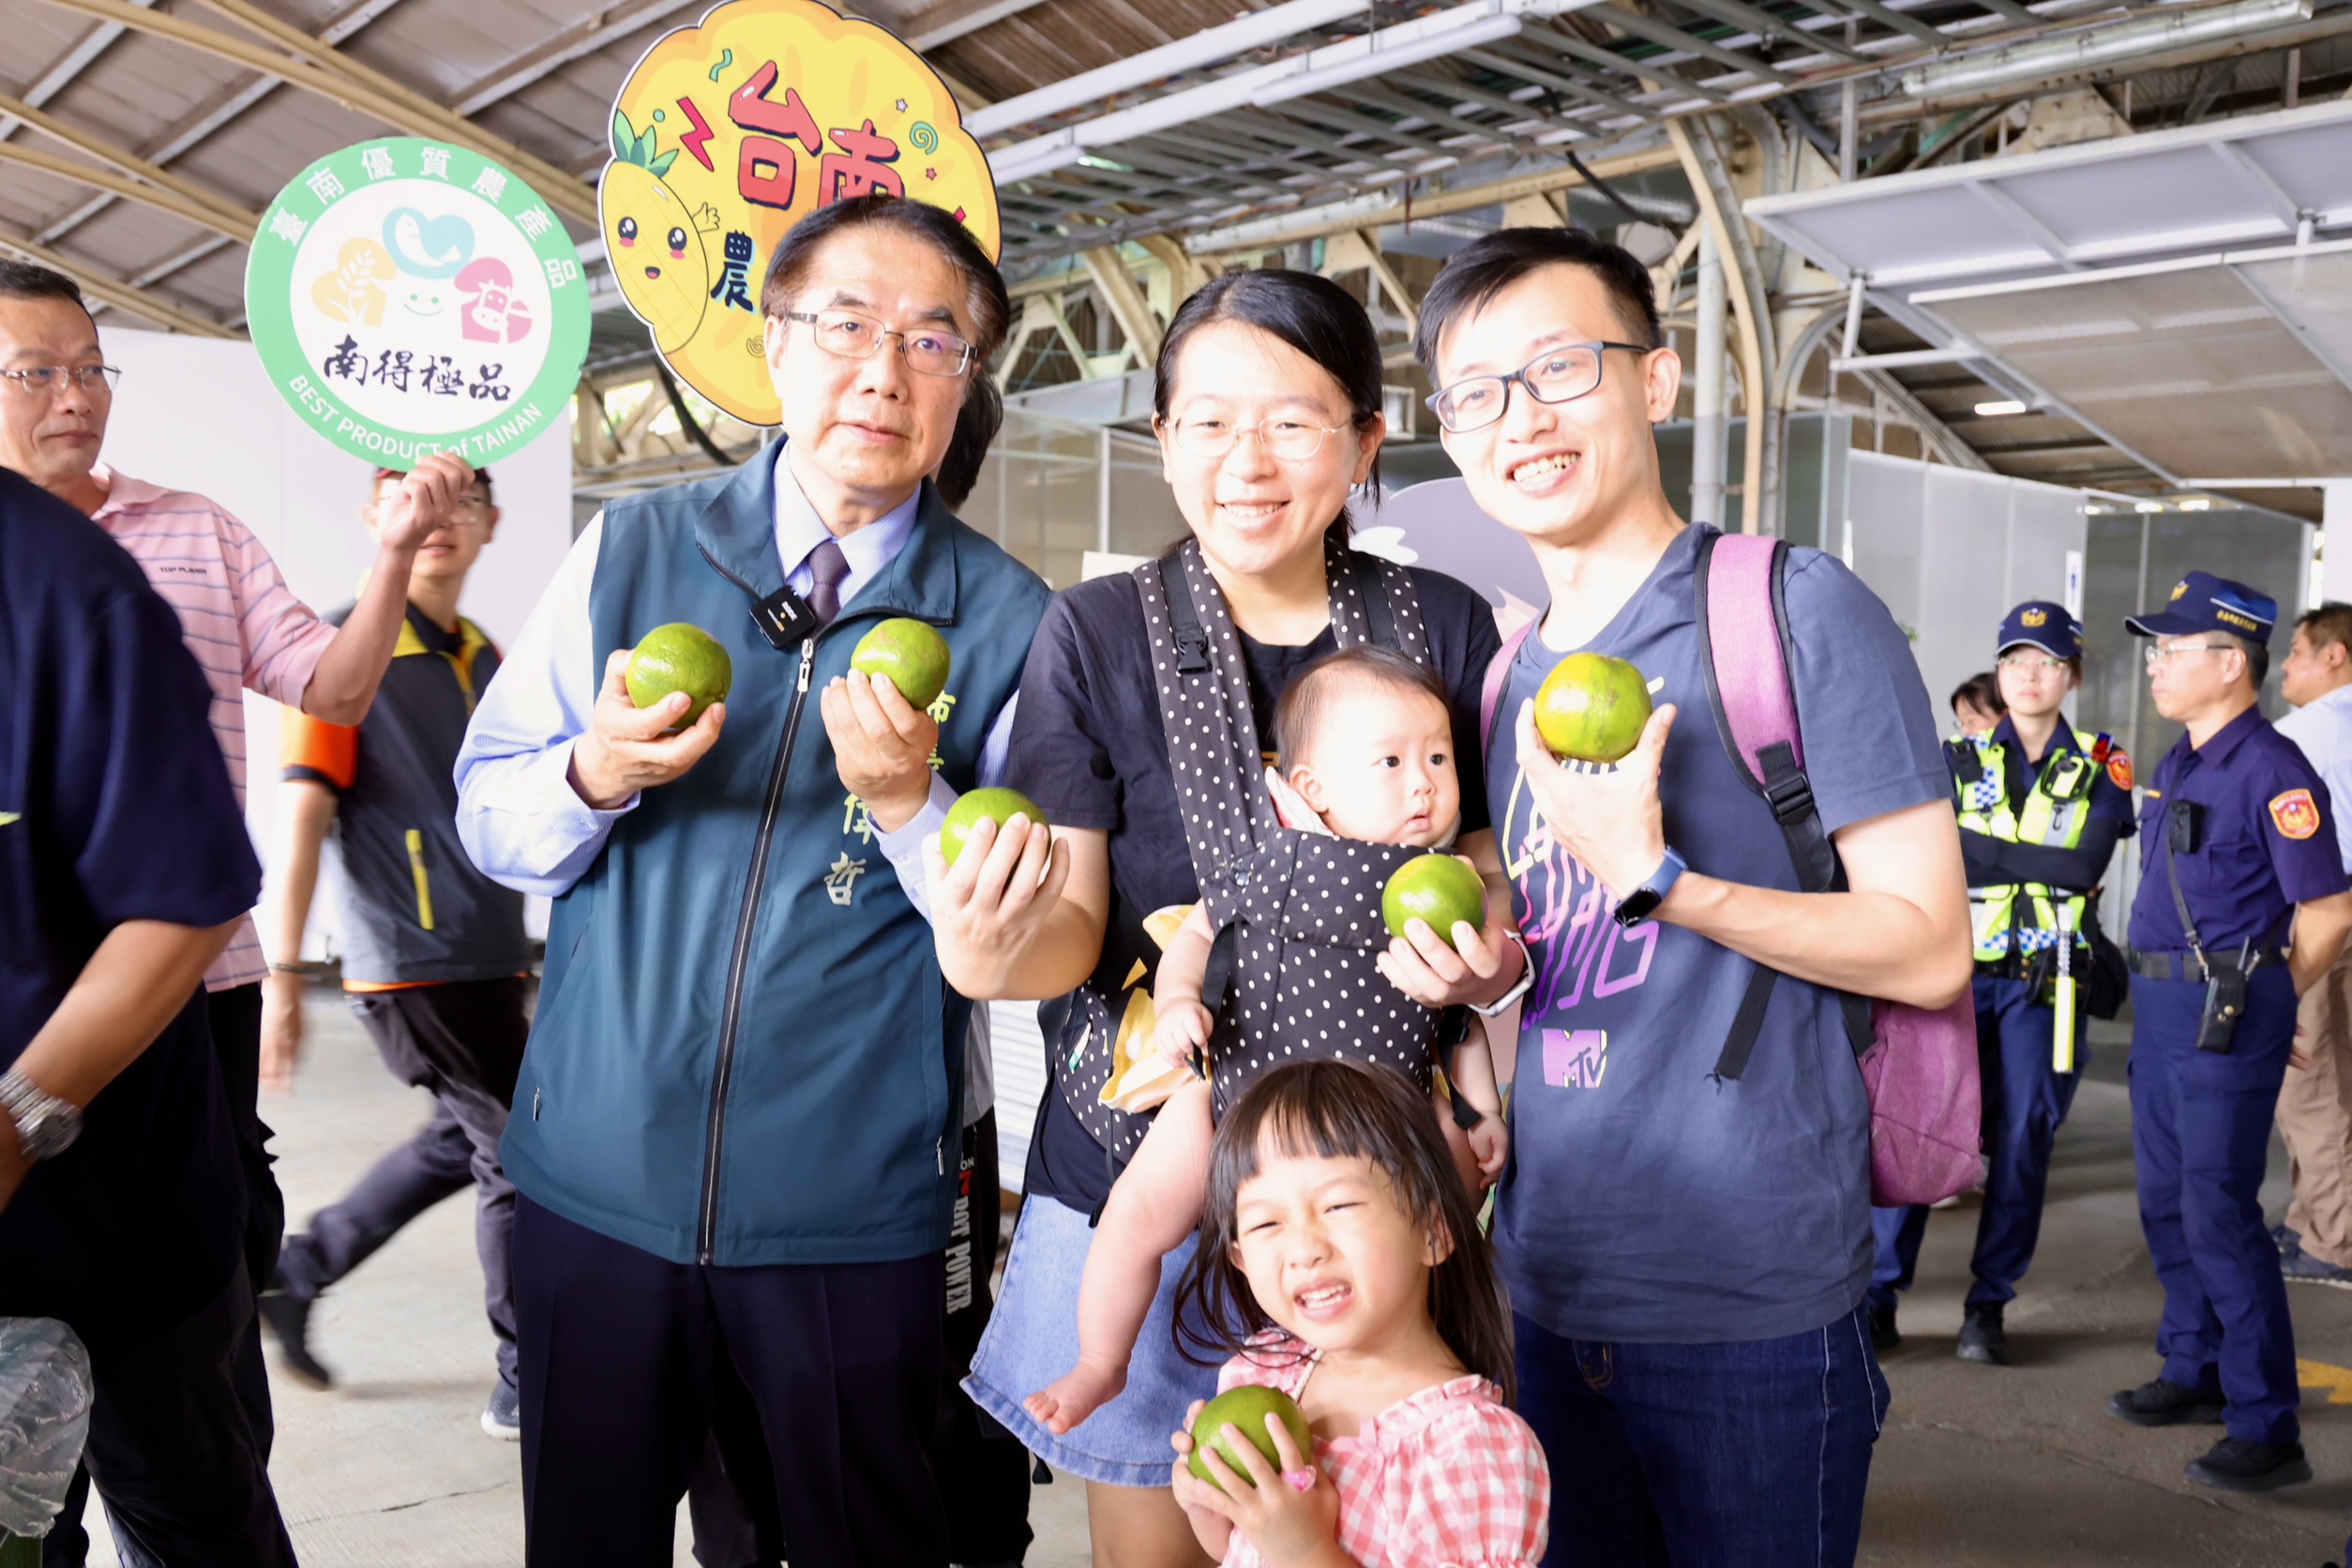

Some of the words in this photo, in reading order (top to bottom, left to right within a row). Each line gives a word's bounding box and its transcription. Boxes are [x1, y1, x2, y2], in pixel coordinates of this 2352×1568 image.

[710, 229, 755, 312] 農
[324, 334, 511, 401] 南得極品
[289, 374, 339, 423] BEST
[337, 415, 441, 460] PRODUCT
[471, 401, 543, 455] TAINAN
[1542, 1028, 1607, 1089] MTV
[944, 1240, 972, 1314] POWER
